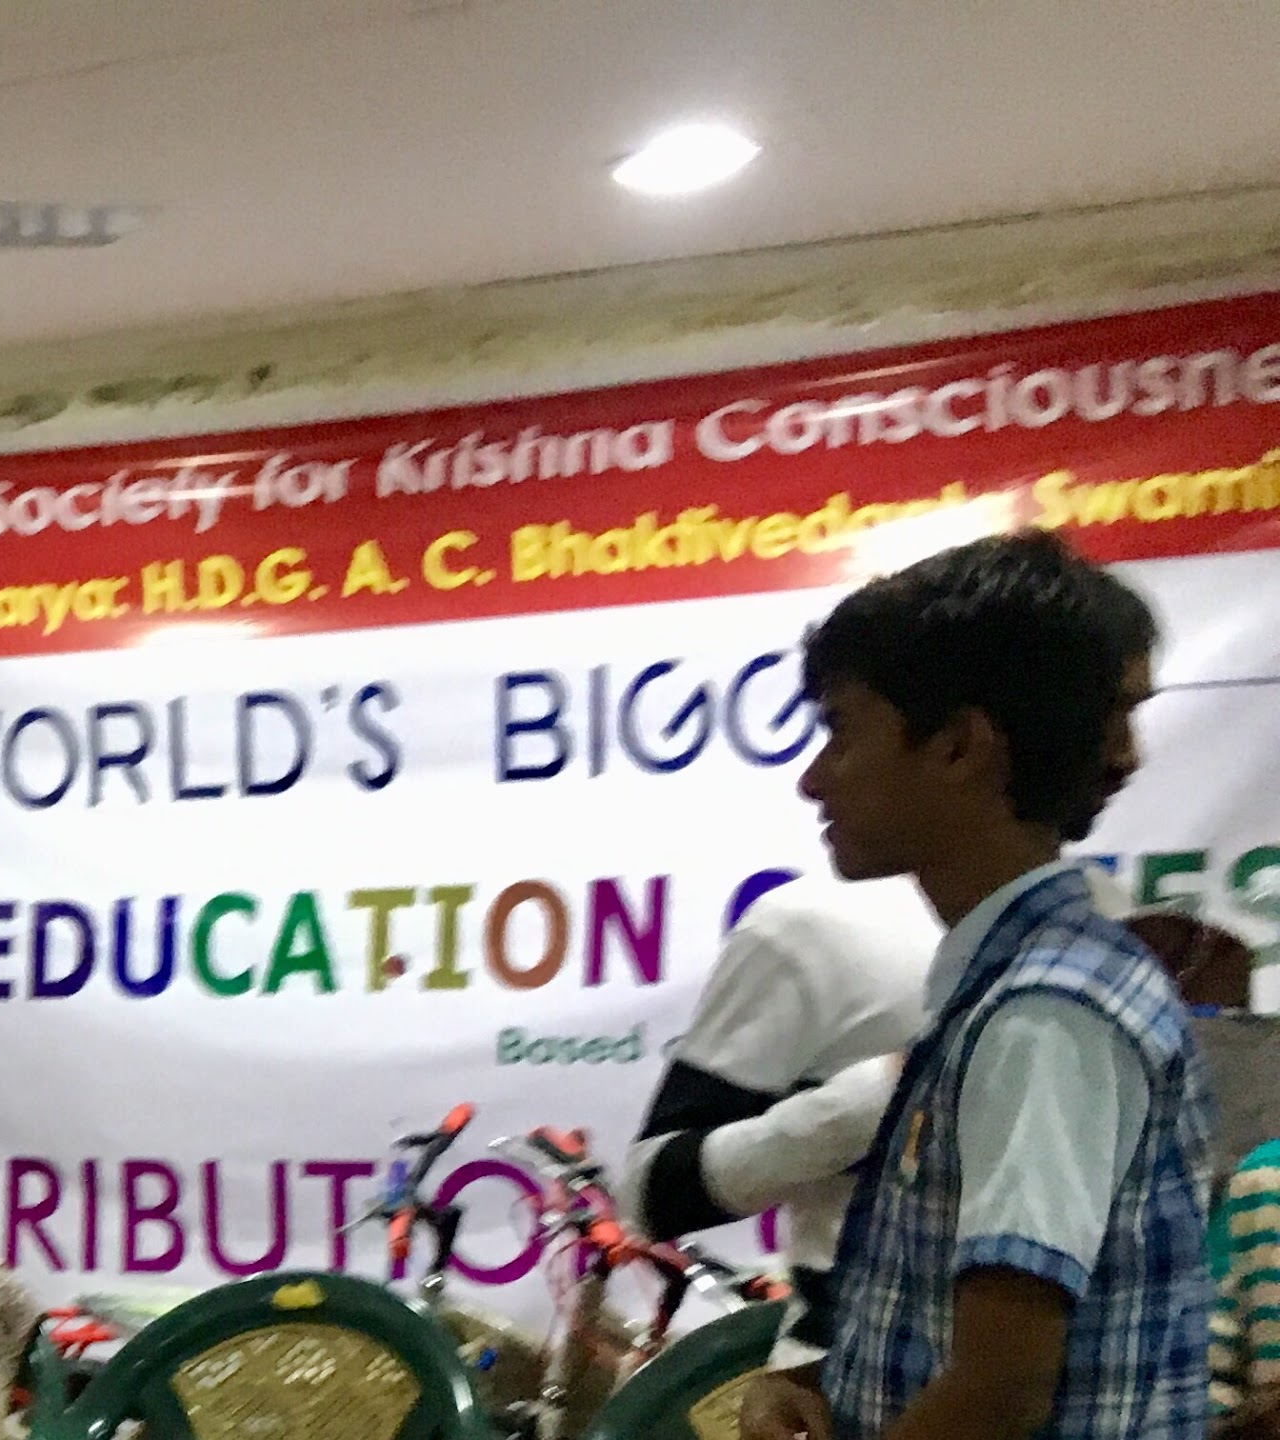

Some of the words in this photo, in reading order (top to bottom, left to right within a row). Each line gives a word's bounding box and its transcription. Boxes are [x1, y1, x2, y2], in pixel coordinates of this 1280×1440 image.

[252, 447, 357, 512] for
[375, 423, 675, 499] Krishna
[509, 479, 1018, 584] Bhaktiveda
[496, 1021, 647, 1066] Based
